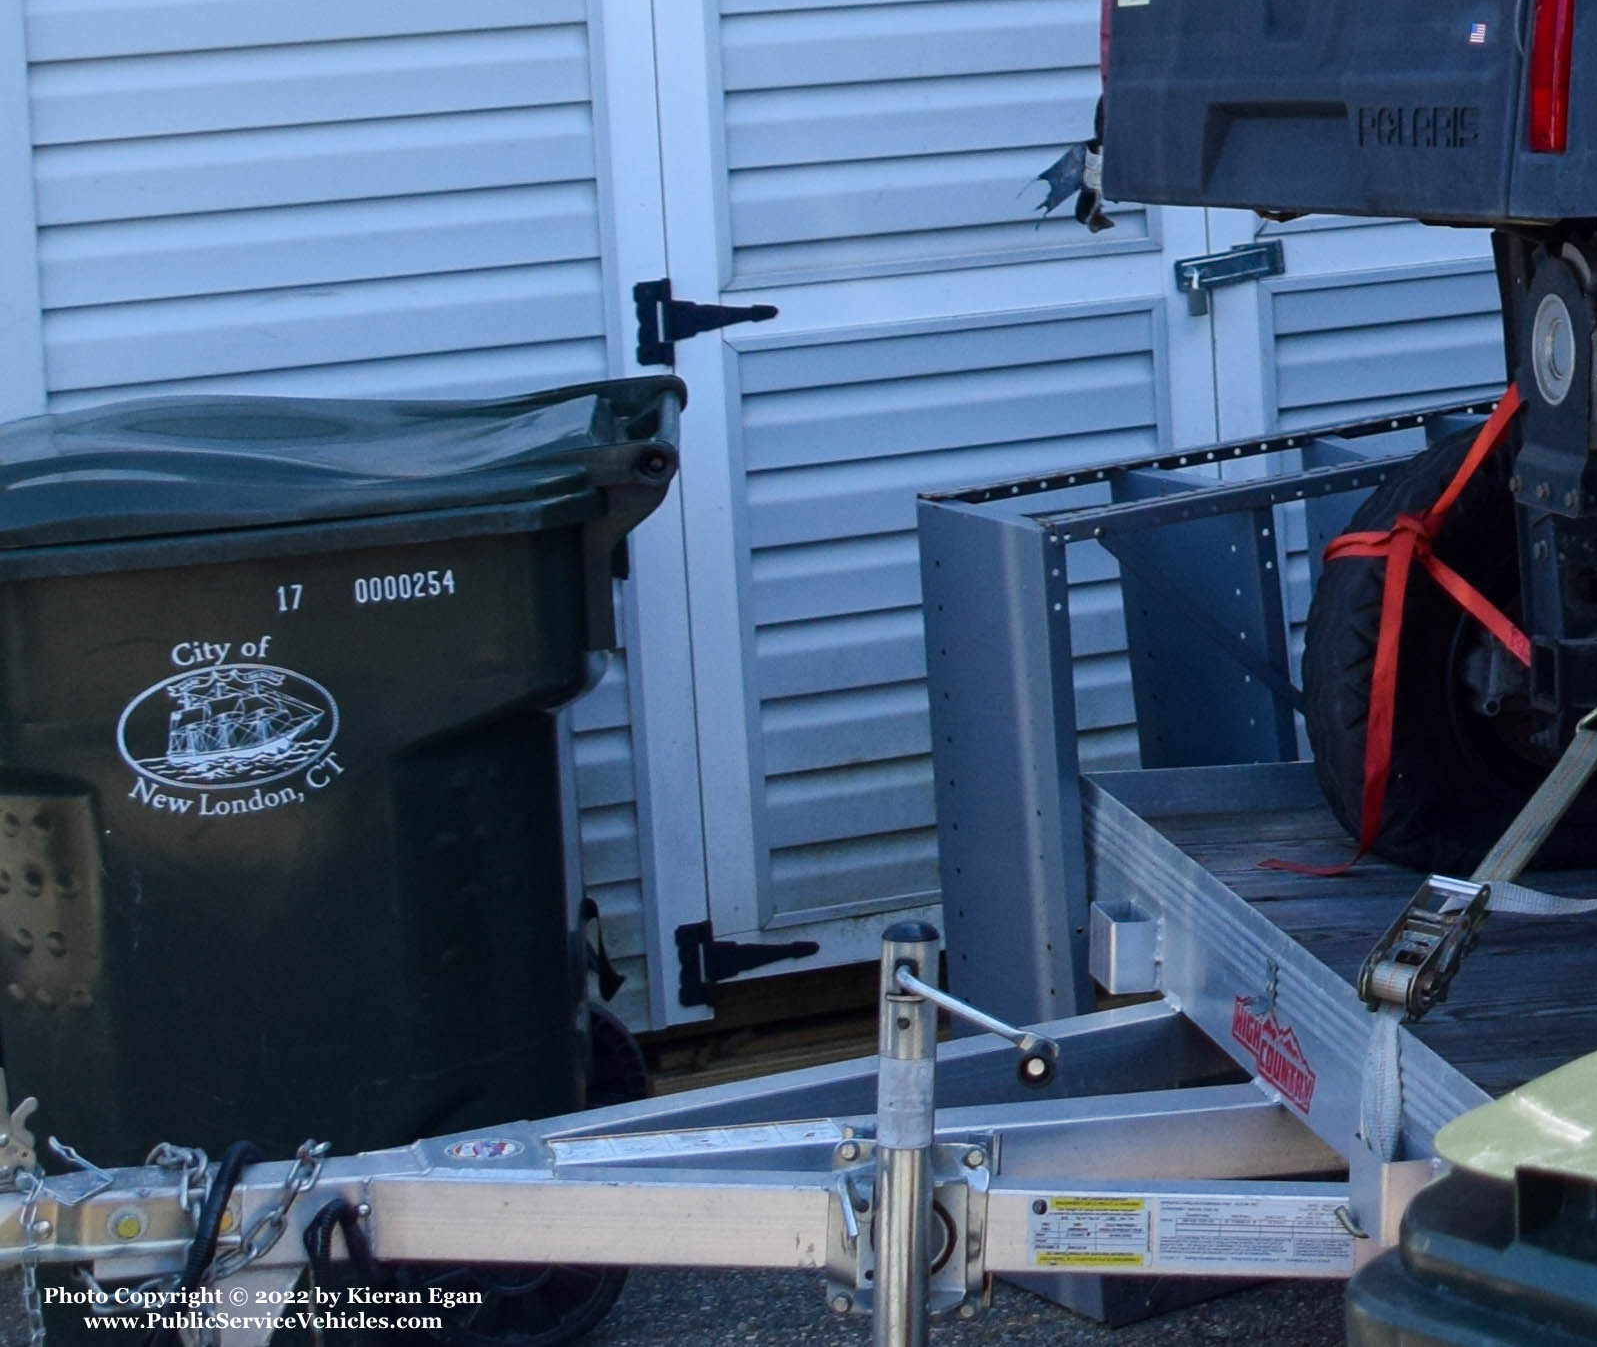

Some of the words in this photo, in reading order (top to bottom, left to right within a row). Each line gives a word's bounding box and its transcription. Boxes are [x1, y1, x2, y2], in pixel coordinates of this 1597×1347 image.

[1357, 106, 1481, 149] POLARIS
[276, 583, 304, 613] 17
[353, 568, 456, 604] 0000254
[171, 640, 231, 667] City
[240, 635, 273, 659] of
[127, 776, 195, 815] New
[199, 786, 305, 817] London,
[304, 752, 346, 790] CT
[1260, 1040, 1315, 1111] COUNTRY
